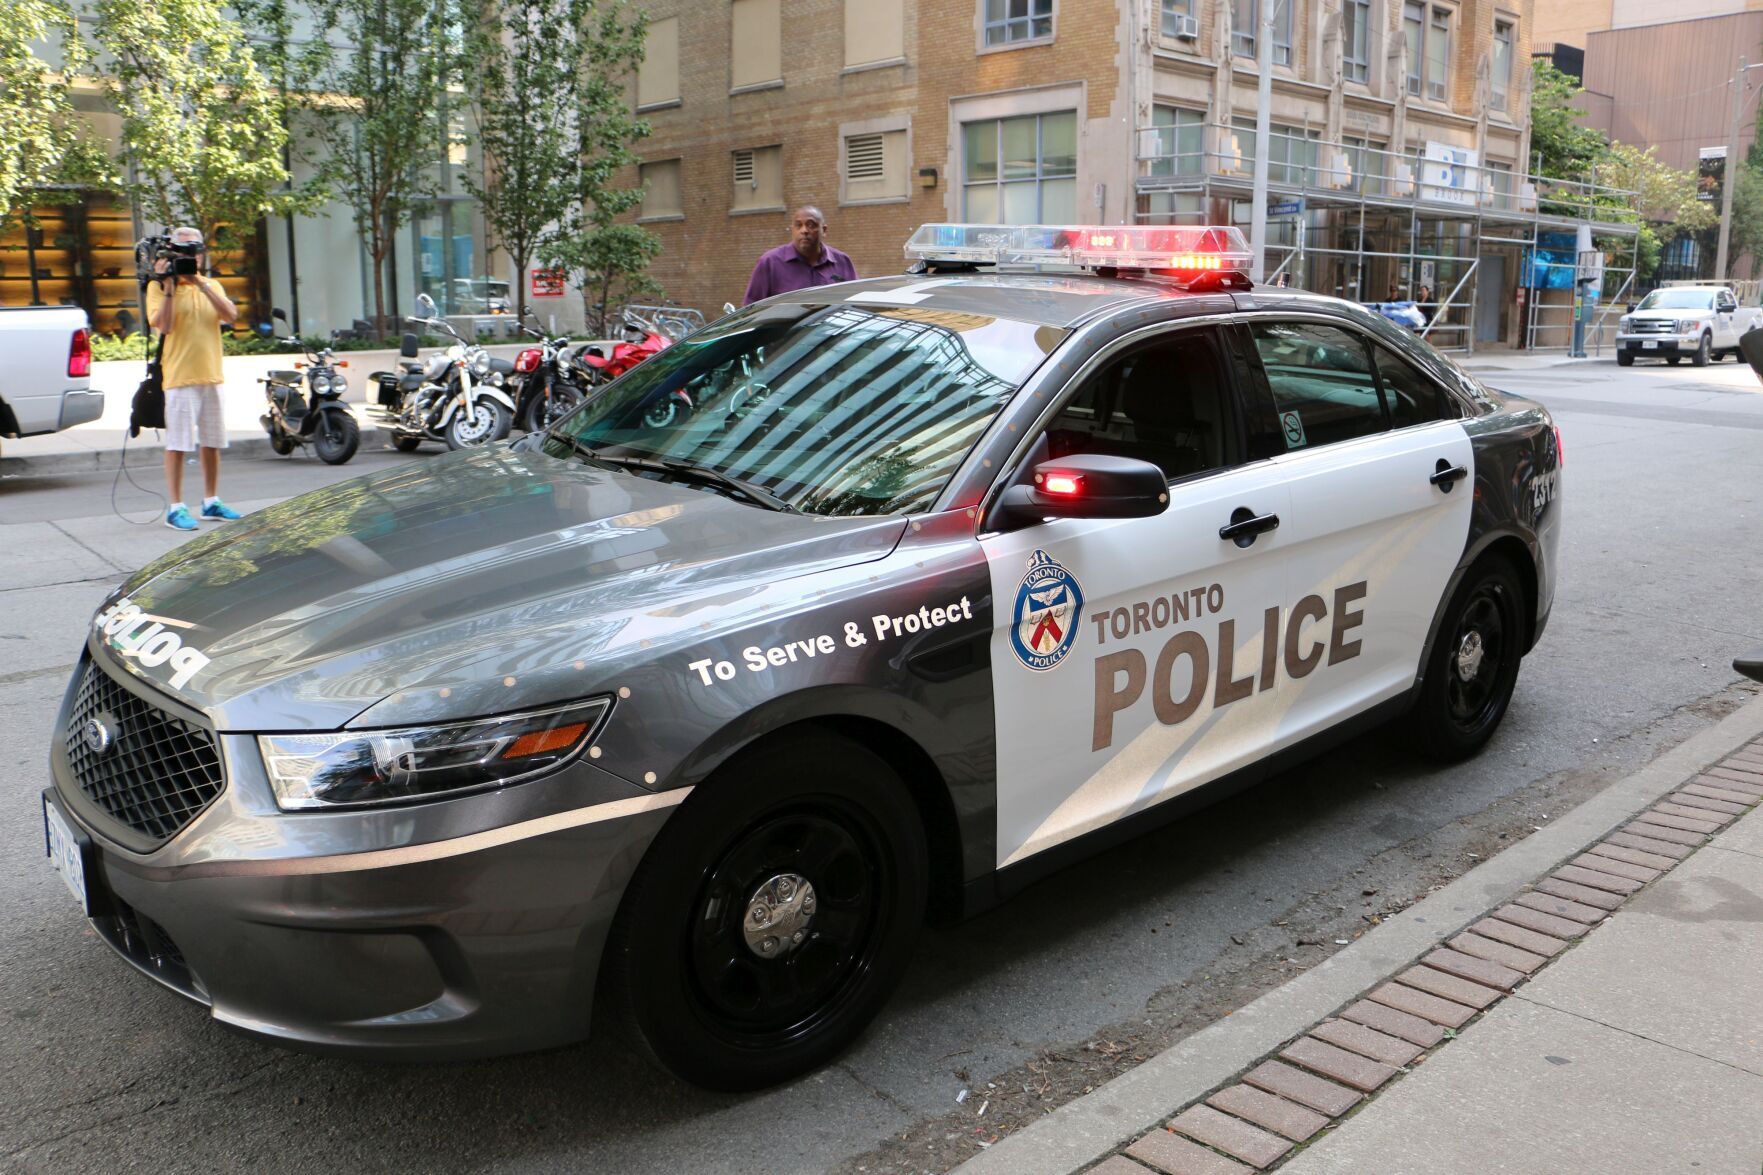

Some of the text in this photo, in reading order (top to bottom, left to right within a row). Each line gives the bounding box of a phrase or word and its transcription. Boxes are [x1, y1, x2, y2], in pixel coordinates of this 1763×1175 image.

[1024, 568, 1066, 588] TORONTO
[688, 595, 973, 687] To Serve & Protect
[1091, 583, 1224, 645] TORONTO
[1033, 650, 1063, 667] POLICE
[1091, 580, 1368, 752] POLICE
